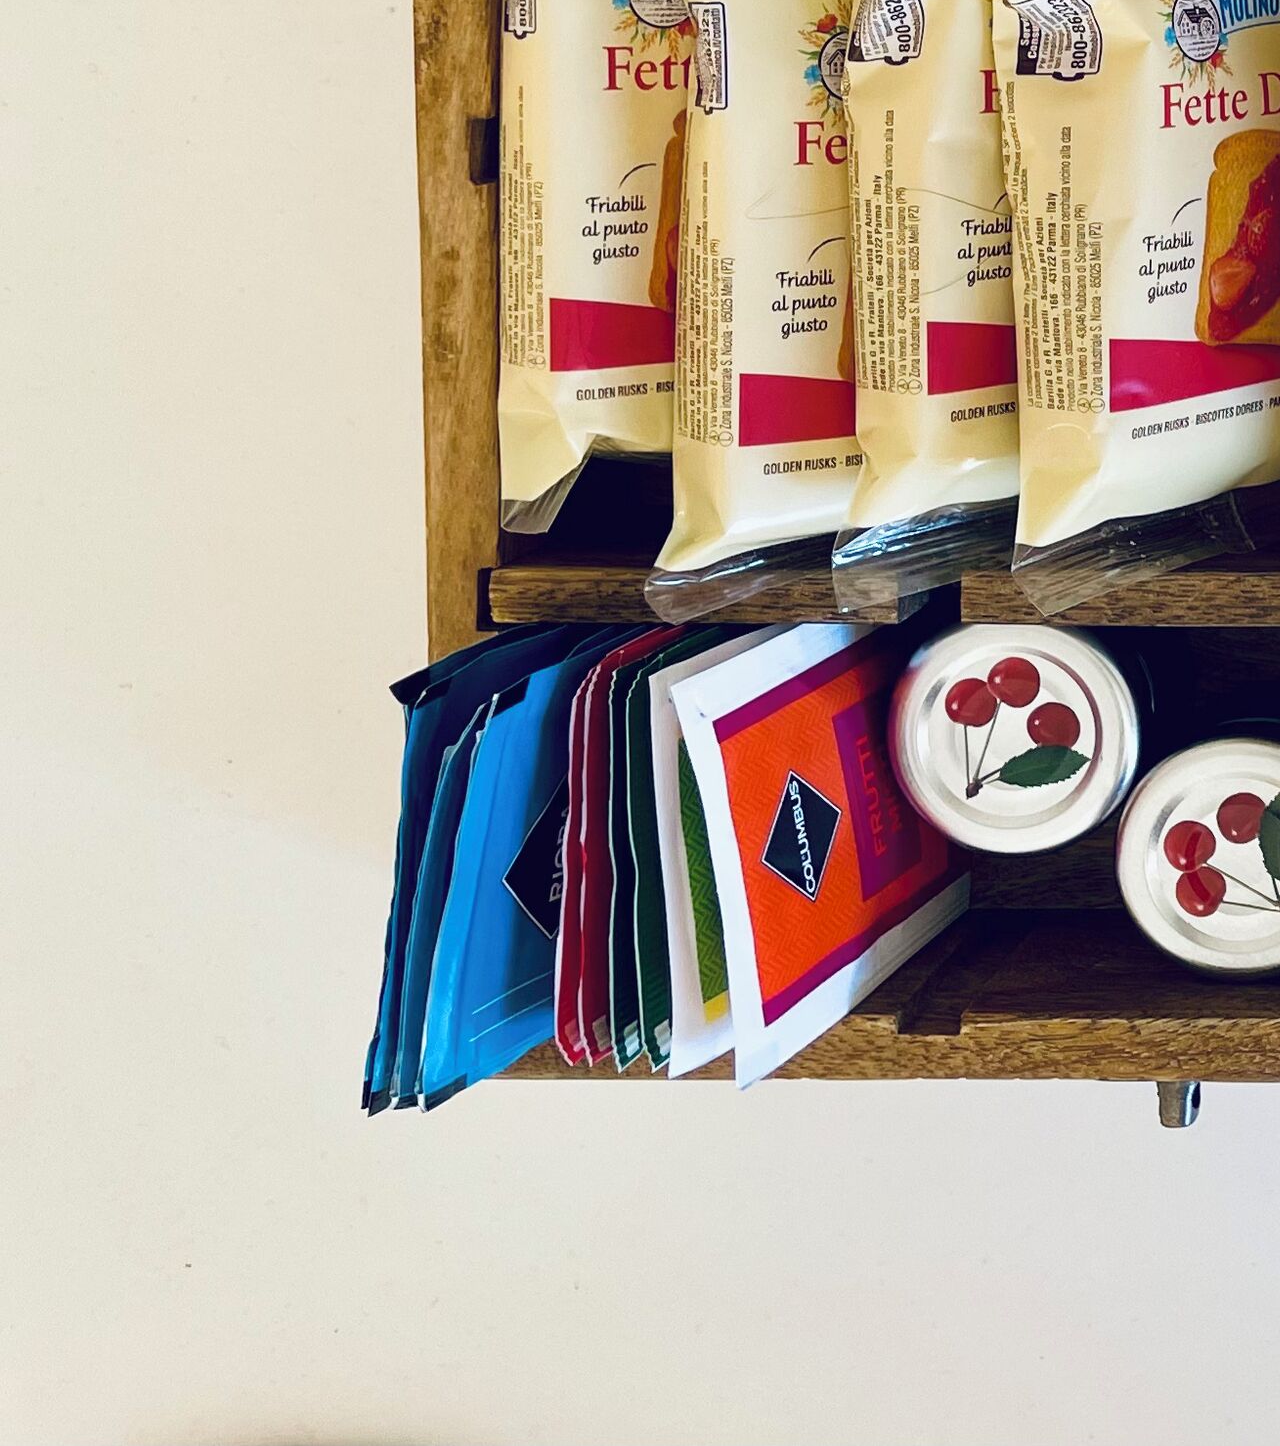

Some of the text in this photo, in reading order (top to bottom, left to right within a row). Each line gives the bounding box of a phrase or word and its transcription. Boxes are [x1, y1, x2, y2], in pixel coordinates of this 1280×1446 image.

[1160, 83, 1248, 129] Fette
[873, 175, 882, 195] Italy
[586, 195, 647, 214] Friabili
[1046, 192, 1058, 213] Italy
[582, 220, 649, 242] al punto
[1047, 222, 1056, 253] Parma
[1142, 231, 1194, 253] Friabili
[593, 243, 640, 265] giusto
[875, 238, 883, 265] 43122
[958, 243, 975, 260] al
[776, 268, 835, 289] Friabili
[967, 265, 1012, 287] giusto
[1048, 256, 1057, 284] 43122
[1139, 256, 1195, 279] al punto
[1049, 294, 1059, 309] 166
[1147, 281, 1188, 304] giusto
[771, 294, 837, 316] al punto
[781, 317, 828, 340] giusto
[576, 386, 616, 401] GOLDEN
[617, 383, 648, 397] RUSKS
[1090, 377, 1103, 396] Zona
[950, 401, 1016, 423] GOLDEN RUSKS
[1131, 421, 1163, 440] GOLDEN
[1164, 417, 1190, 433] RUSKS
[1195, 406, 1234, 425] BISCOTTES
[763, 459, 802, 475] GOLDEN
[804, 456, 837, 471] RUSKS
[856, 734, 886, 858] FRUTTI
[789, 780, 817, 894] COLUMBUS
